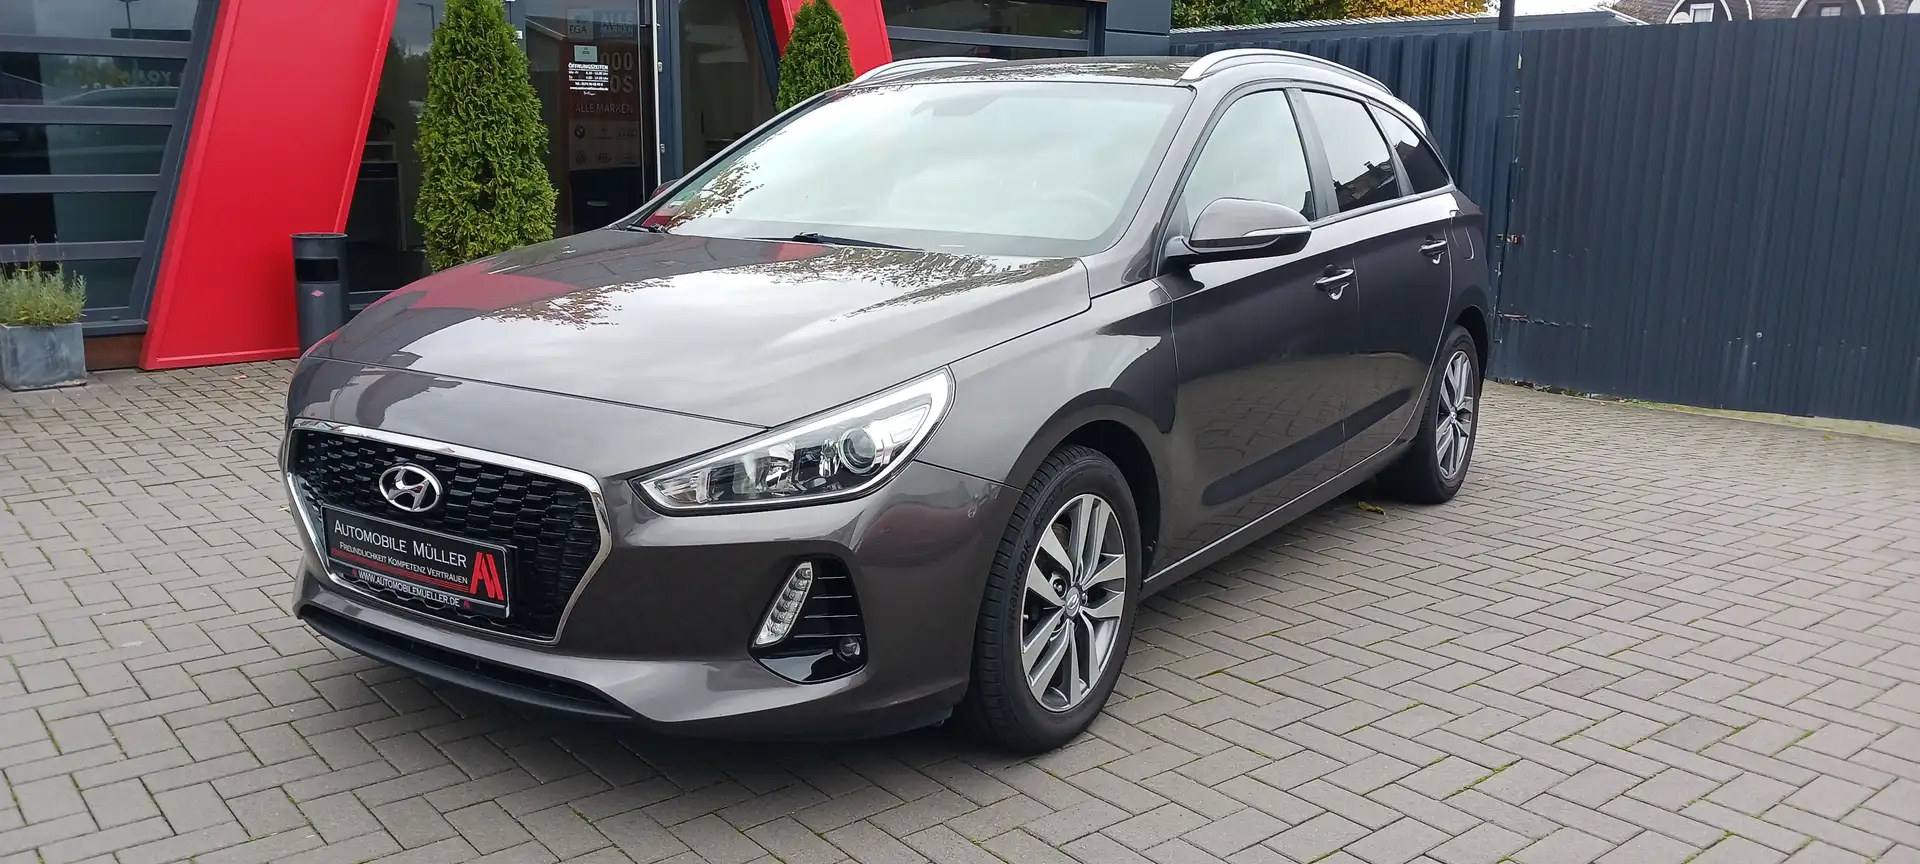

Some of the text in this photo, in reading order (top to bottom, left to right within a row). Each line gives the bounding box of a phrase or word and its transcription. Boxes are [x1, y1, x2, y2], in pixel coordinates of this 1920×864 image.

[575, 103, 634, 114] ALLE MARKEN
[334, 519, 467, 569] AUTOMOBILE MÜLLER
[339, 541, 468, 585] FREUNDLICHKEIT KOMPETENZ VERTRAUEN
[358, 570, 461, 607] WWW.AUTOMOBILEMUELLER.DE
